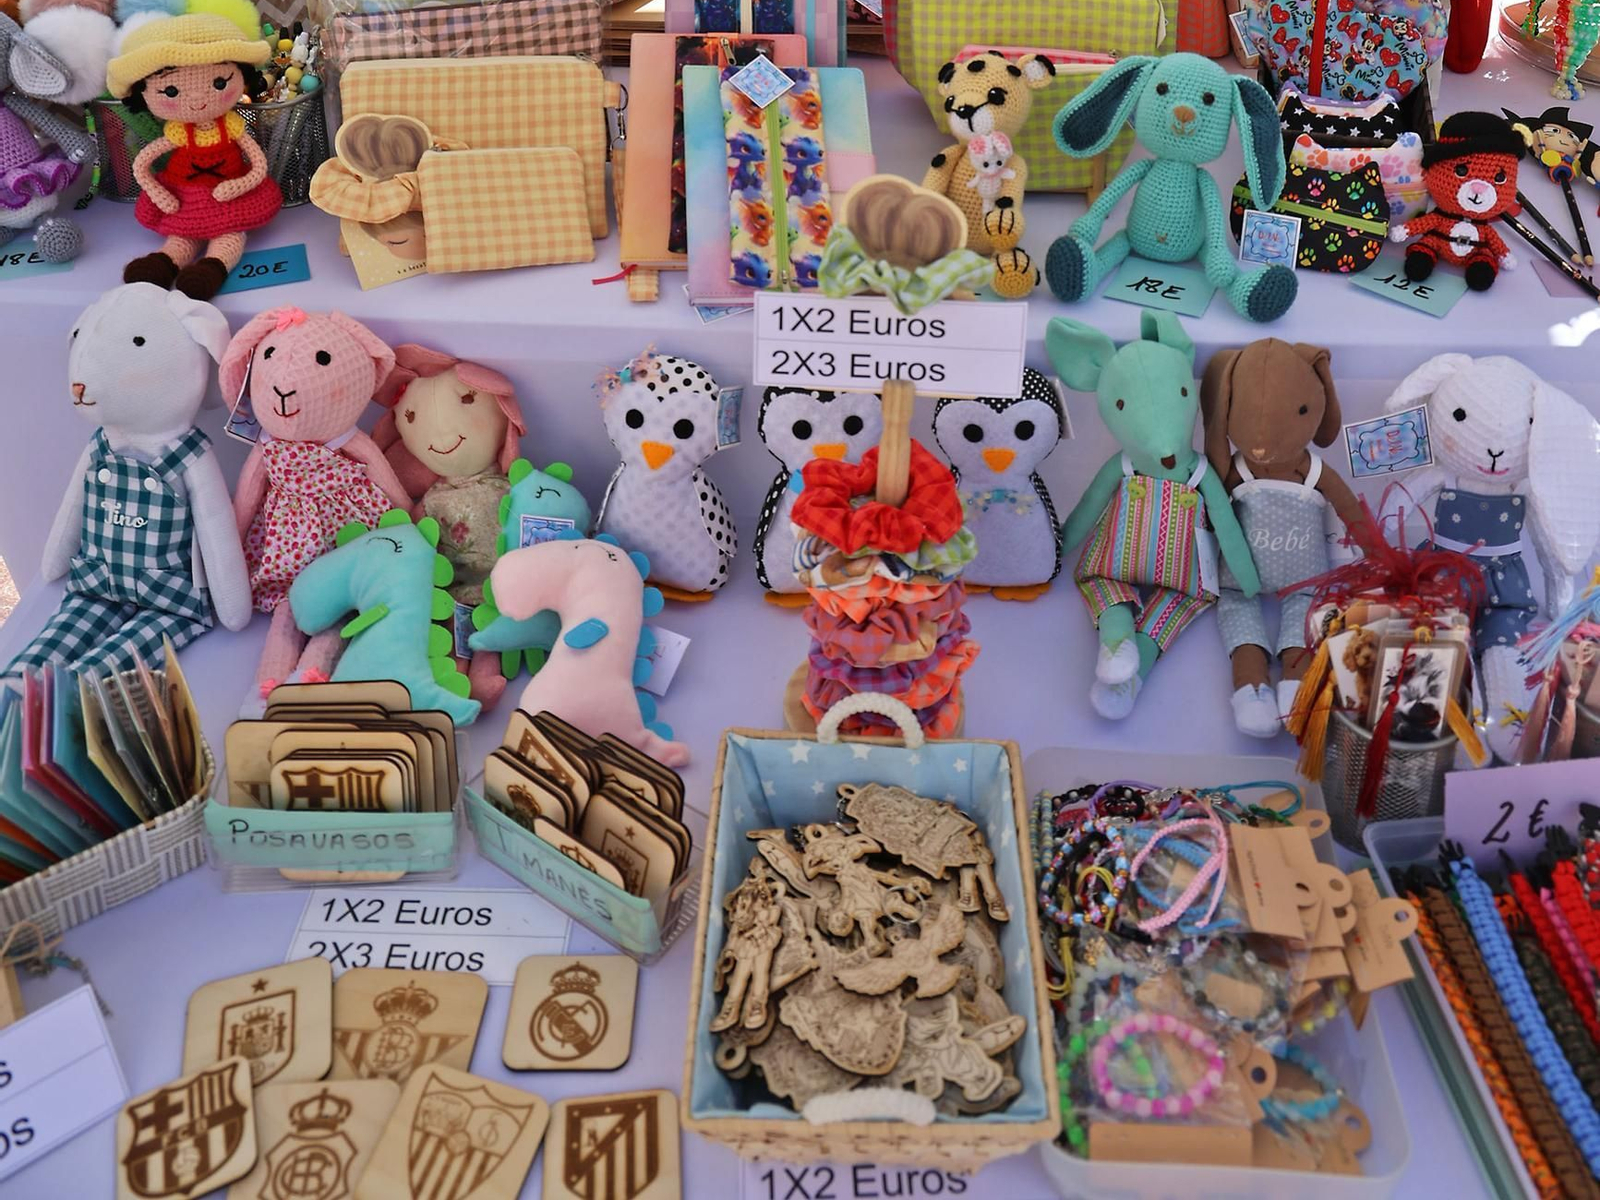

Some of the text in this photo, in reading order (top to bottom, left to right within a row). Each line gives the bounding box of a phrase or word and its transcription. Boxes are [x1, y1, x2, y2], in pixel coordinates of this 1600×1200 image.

[772, 306, 946, 338] 1X2 Euros
[771, 350, 946, 382] 2X3 Euros
[101, 501, 149, 528] Tino
[1248, 526, 1313, 551] Bebé
[322, 898, 492, 926] 1X2 Euros
[308, 941, 485, 972] 2X3 Euros
[761, 1163, 968, 1200] 1X2 Euros
